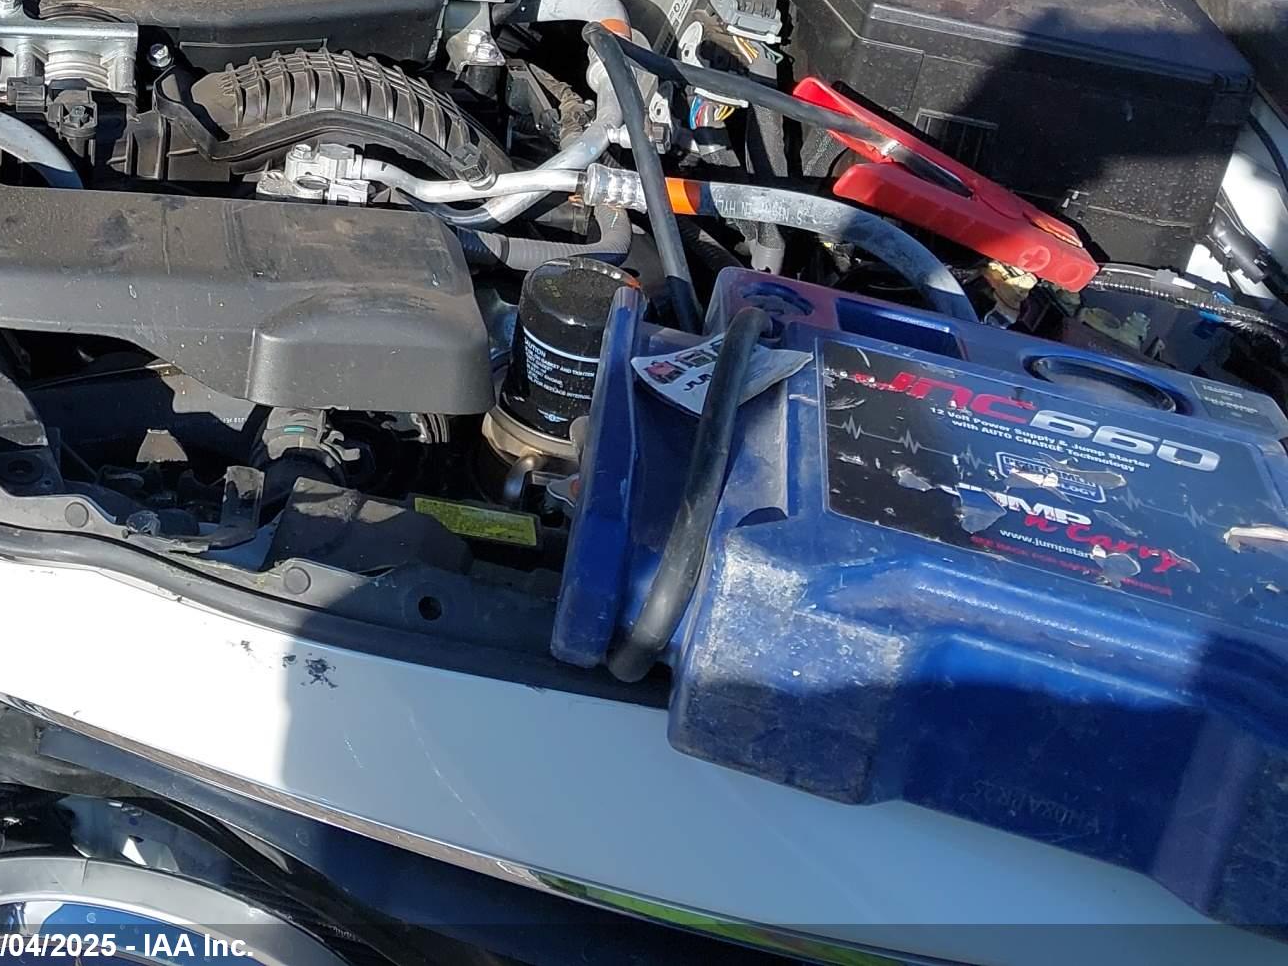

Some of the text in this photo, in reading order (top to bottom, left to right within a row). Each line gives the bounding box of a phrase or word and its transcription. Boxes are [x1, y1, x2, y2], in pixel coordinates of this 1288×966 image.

[930, 407, 945, 415] 12
[947, 410, 971, 422] Volt
[972, 416, 1011, 432] Power
[1014, 428, 1056, 444] Supply
[1072, 444, 1106, 458] Jump
[1108, 452, 1151, 468] Starter
[952, 420, 1135, 472] with AUTO CHARGE Technology
